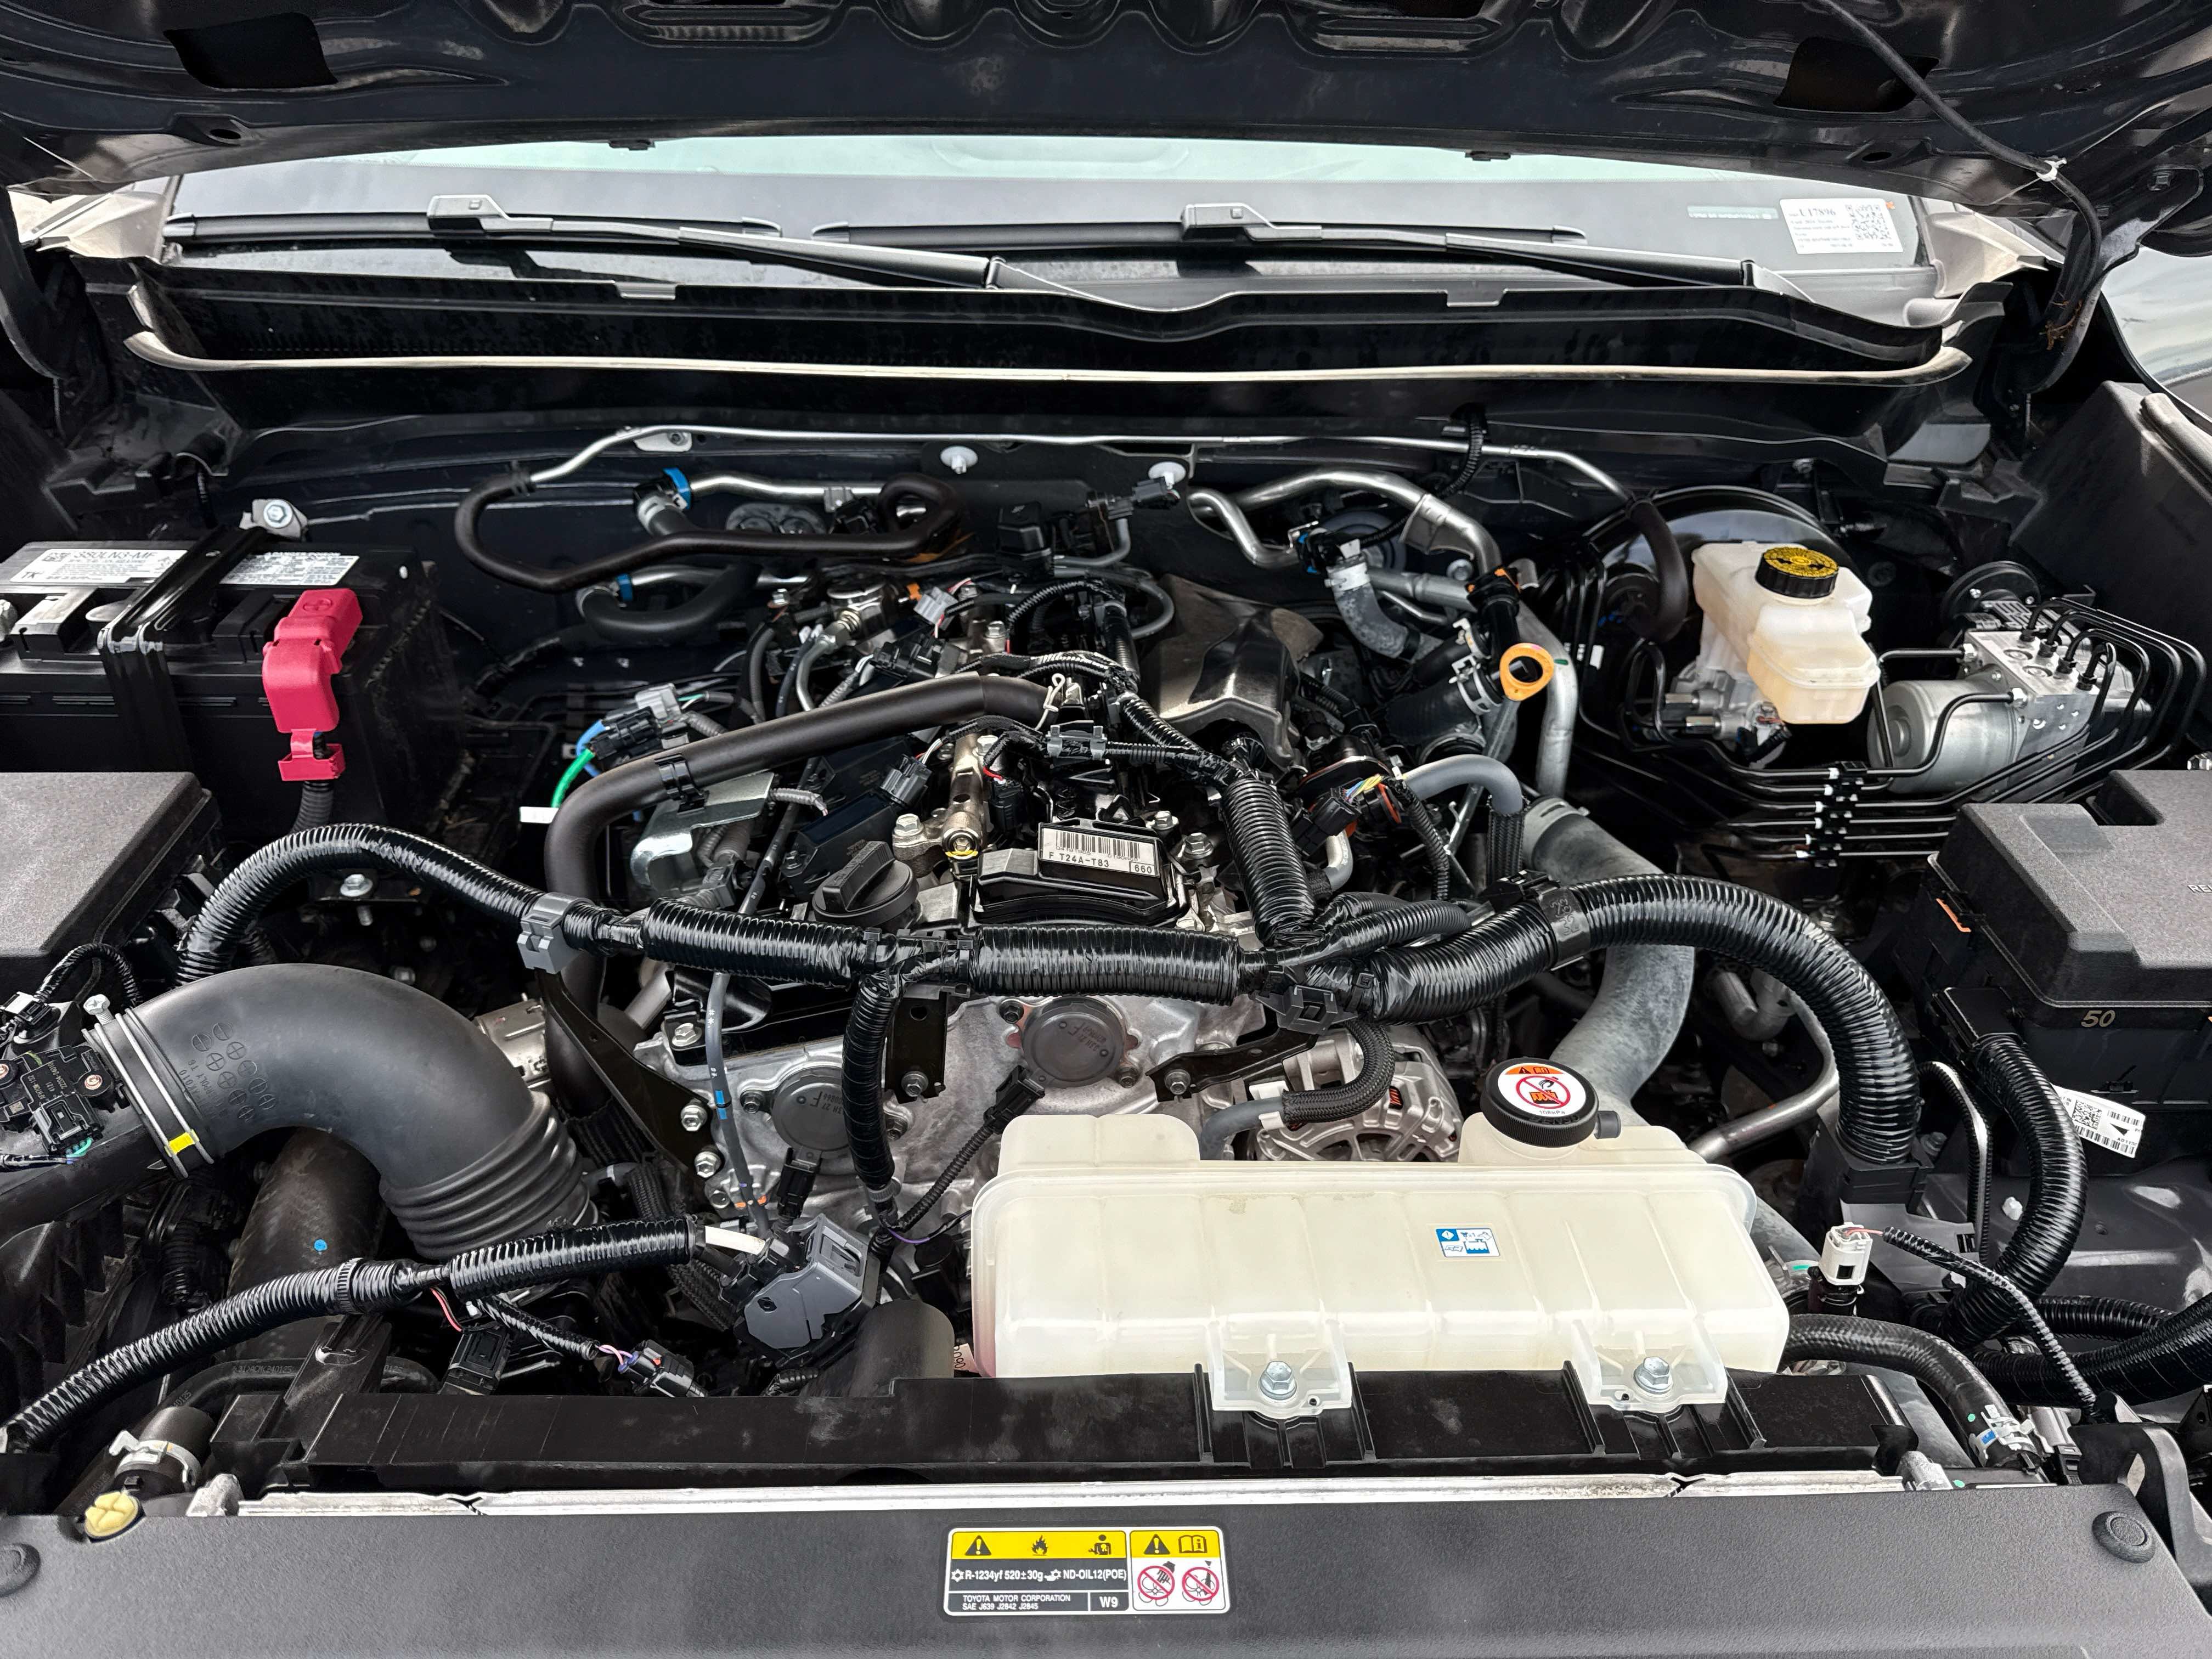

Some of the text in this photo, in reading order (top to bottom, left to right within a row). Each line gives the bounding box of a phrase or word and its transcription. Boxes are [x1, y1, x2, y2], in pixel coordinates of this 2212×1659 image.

[1059, 853, 1109, 867] T24A-T83
[1134, 864, 1152, 874] 660
[2081, 1010, 2115, 1028] 50
[810, 1091, 823, 1108] F
[964, 1569, 1127, 1582] R-1234yf 520±30g ND-OIL12(POE)
[963, 1594, 990, 1602] TOYOTA
[1020, 1594, 1071, 1602] CORPORATION
[1099, 1596, 1119, 1608] W9
